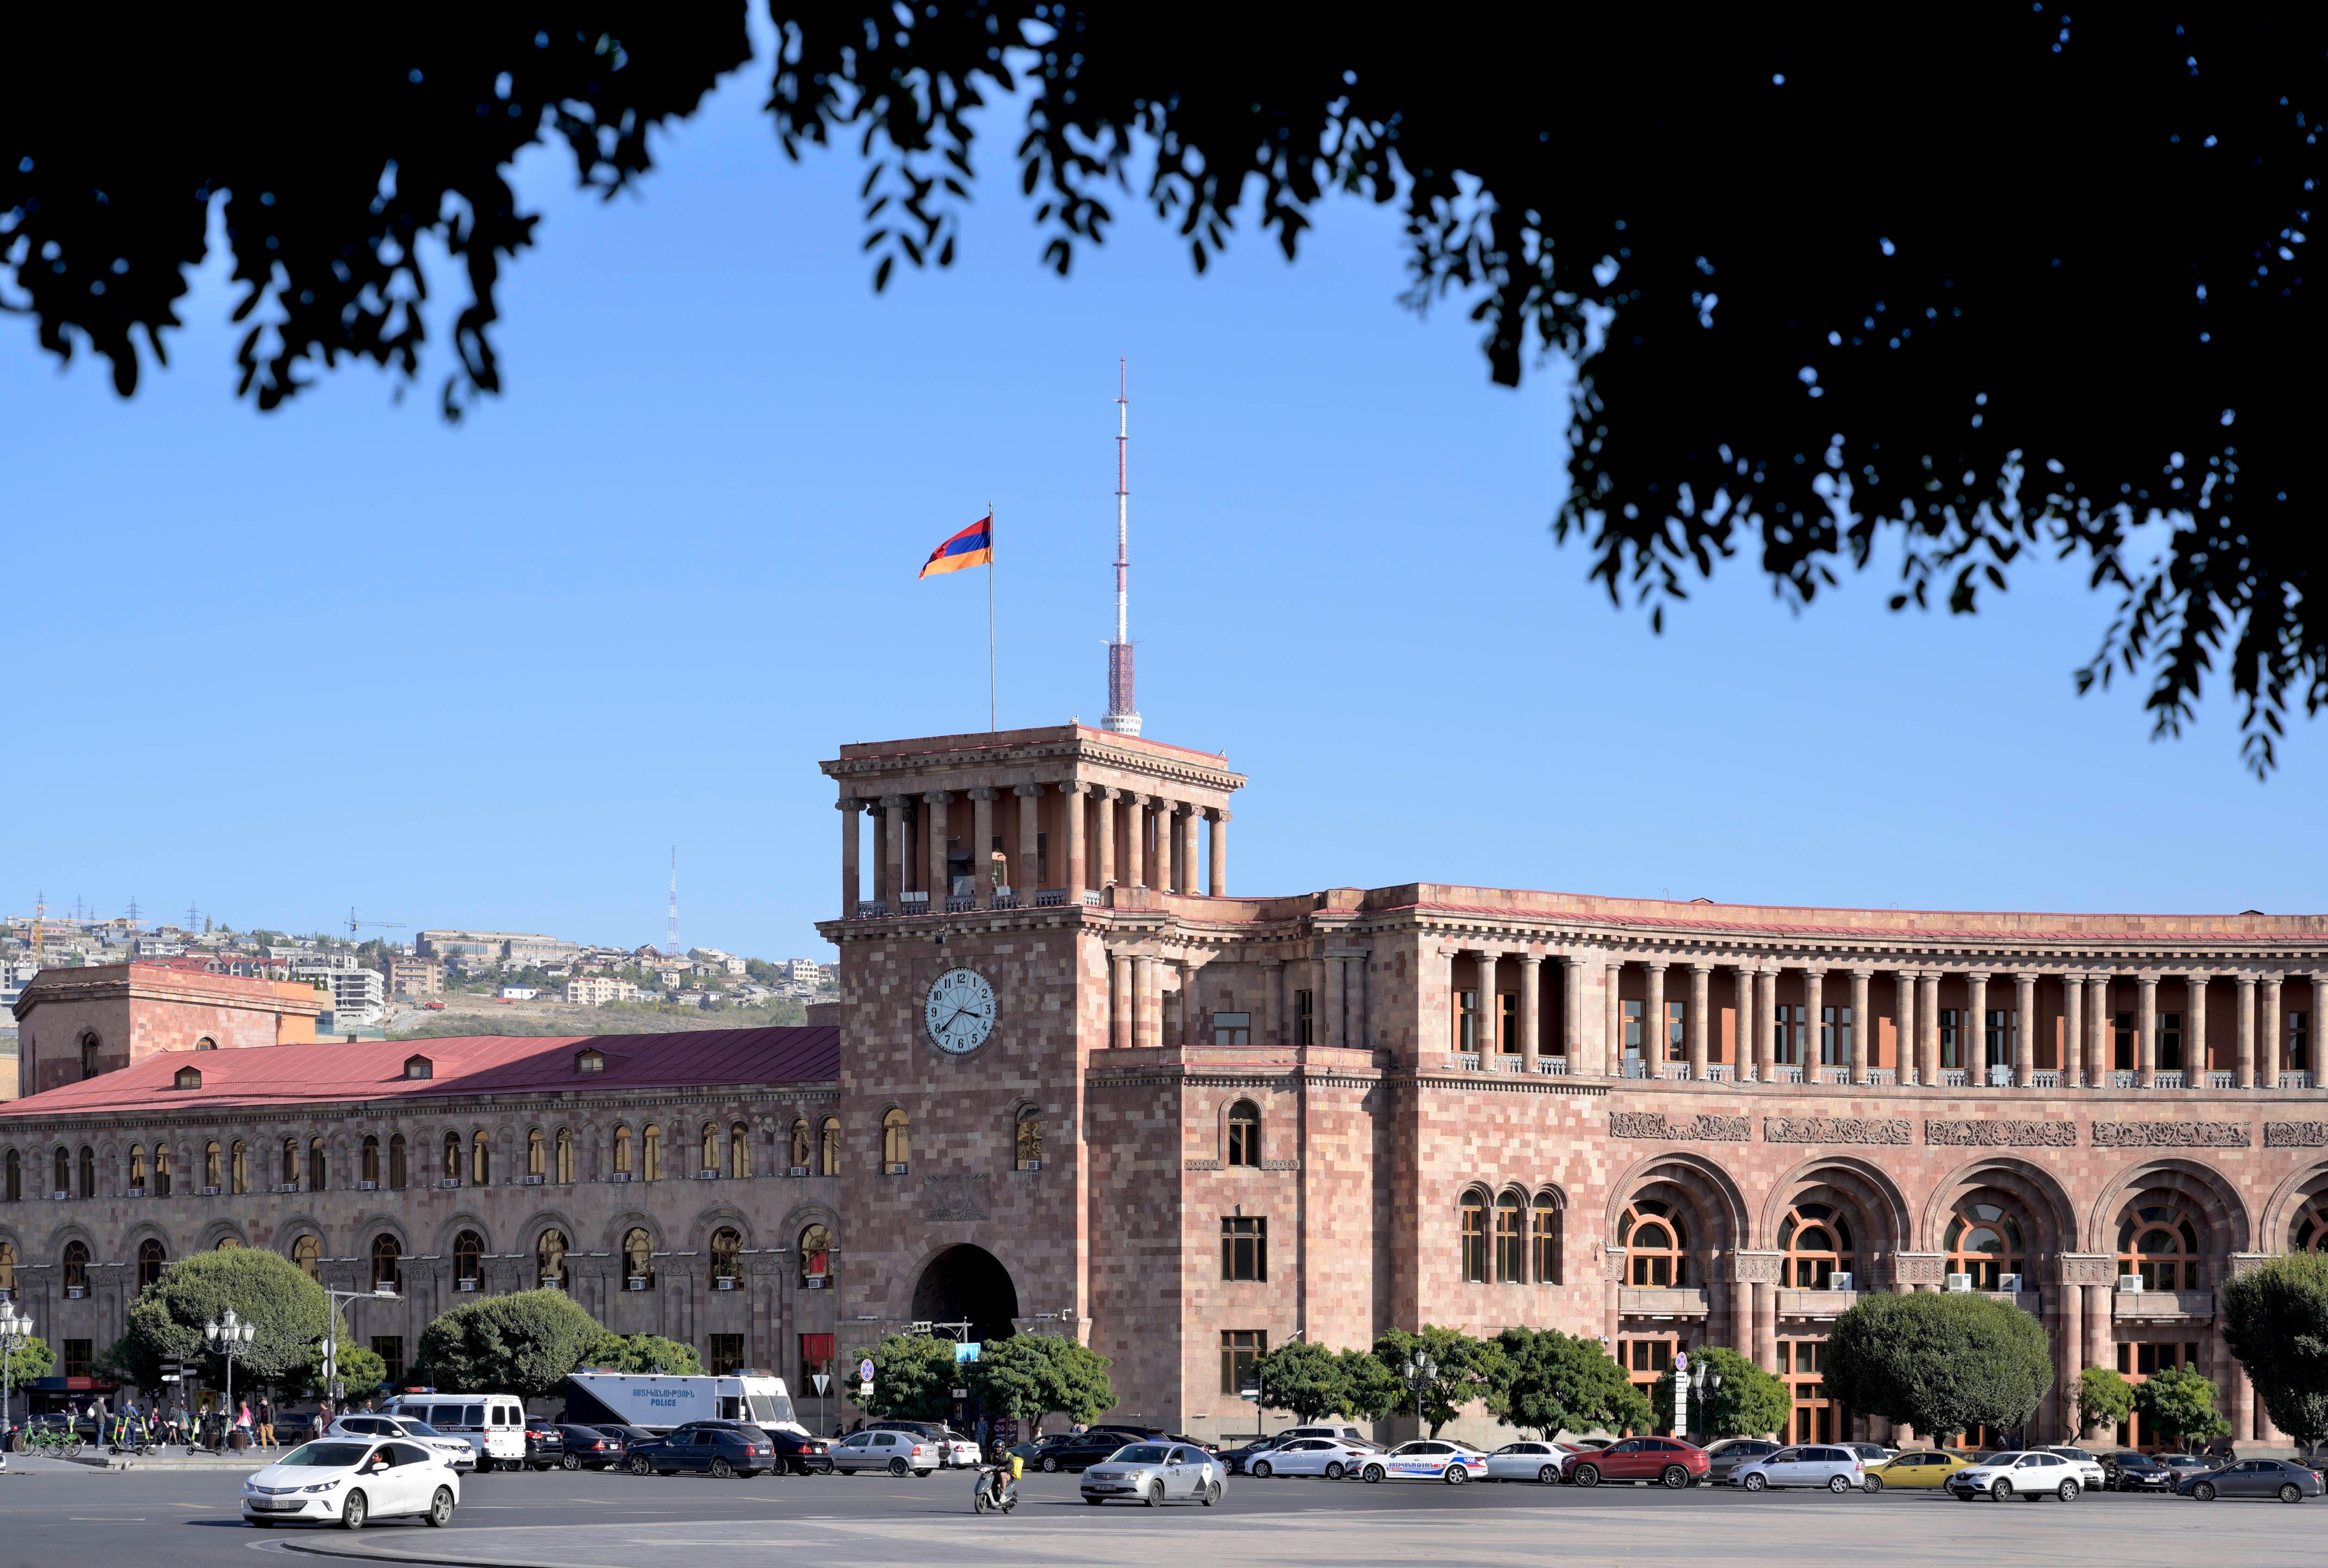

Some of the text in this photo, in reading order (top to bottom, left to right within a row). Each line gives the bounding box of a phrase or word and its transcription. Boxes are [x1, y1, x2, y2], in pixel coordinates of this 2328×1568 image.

[957, 973, 965, 983] 12
[973, 977, 976, 987] 1
[945, 978, 951, 989] 11
[934, 991, 941, 1001] 10
[982, 989, 988, 998] 2
[931, 1007, 937, 1017] 9
[985, 1004, 991, 1014] 3
[935, 1023, 940, 1033] 8
[982, 1021, 987, 1031] 4
[945, 1035, 951, 1045] 7
[958, 1039, 964, 1048] 6
[972, 1034, 977, 1044] 5
[632, 1389, 695, 1398] ՈՍՏԻԿԱՆՈՒԹՅՈՒՆ
